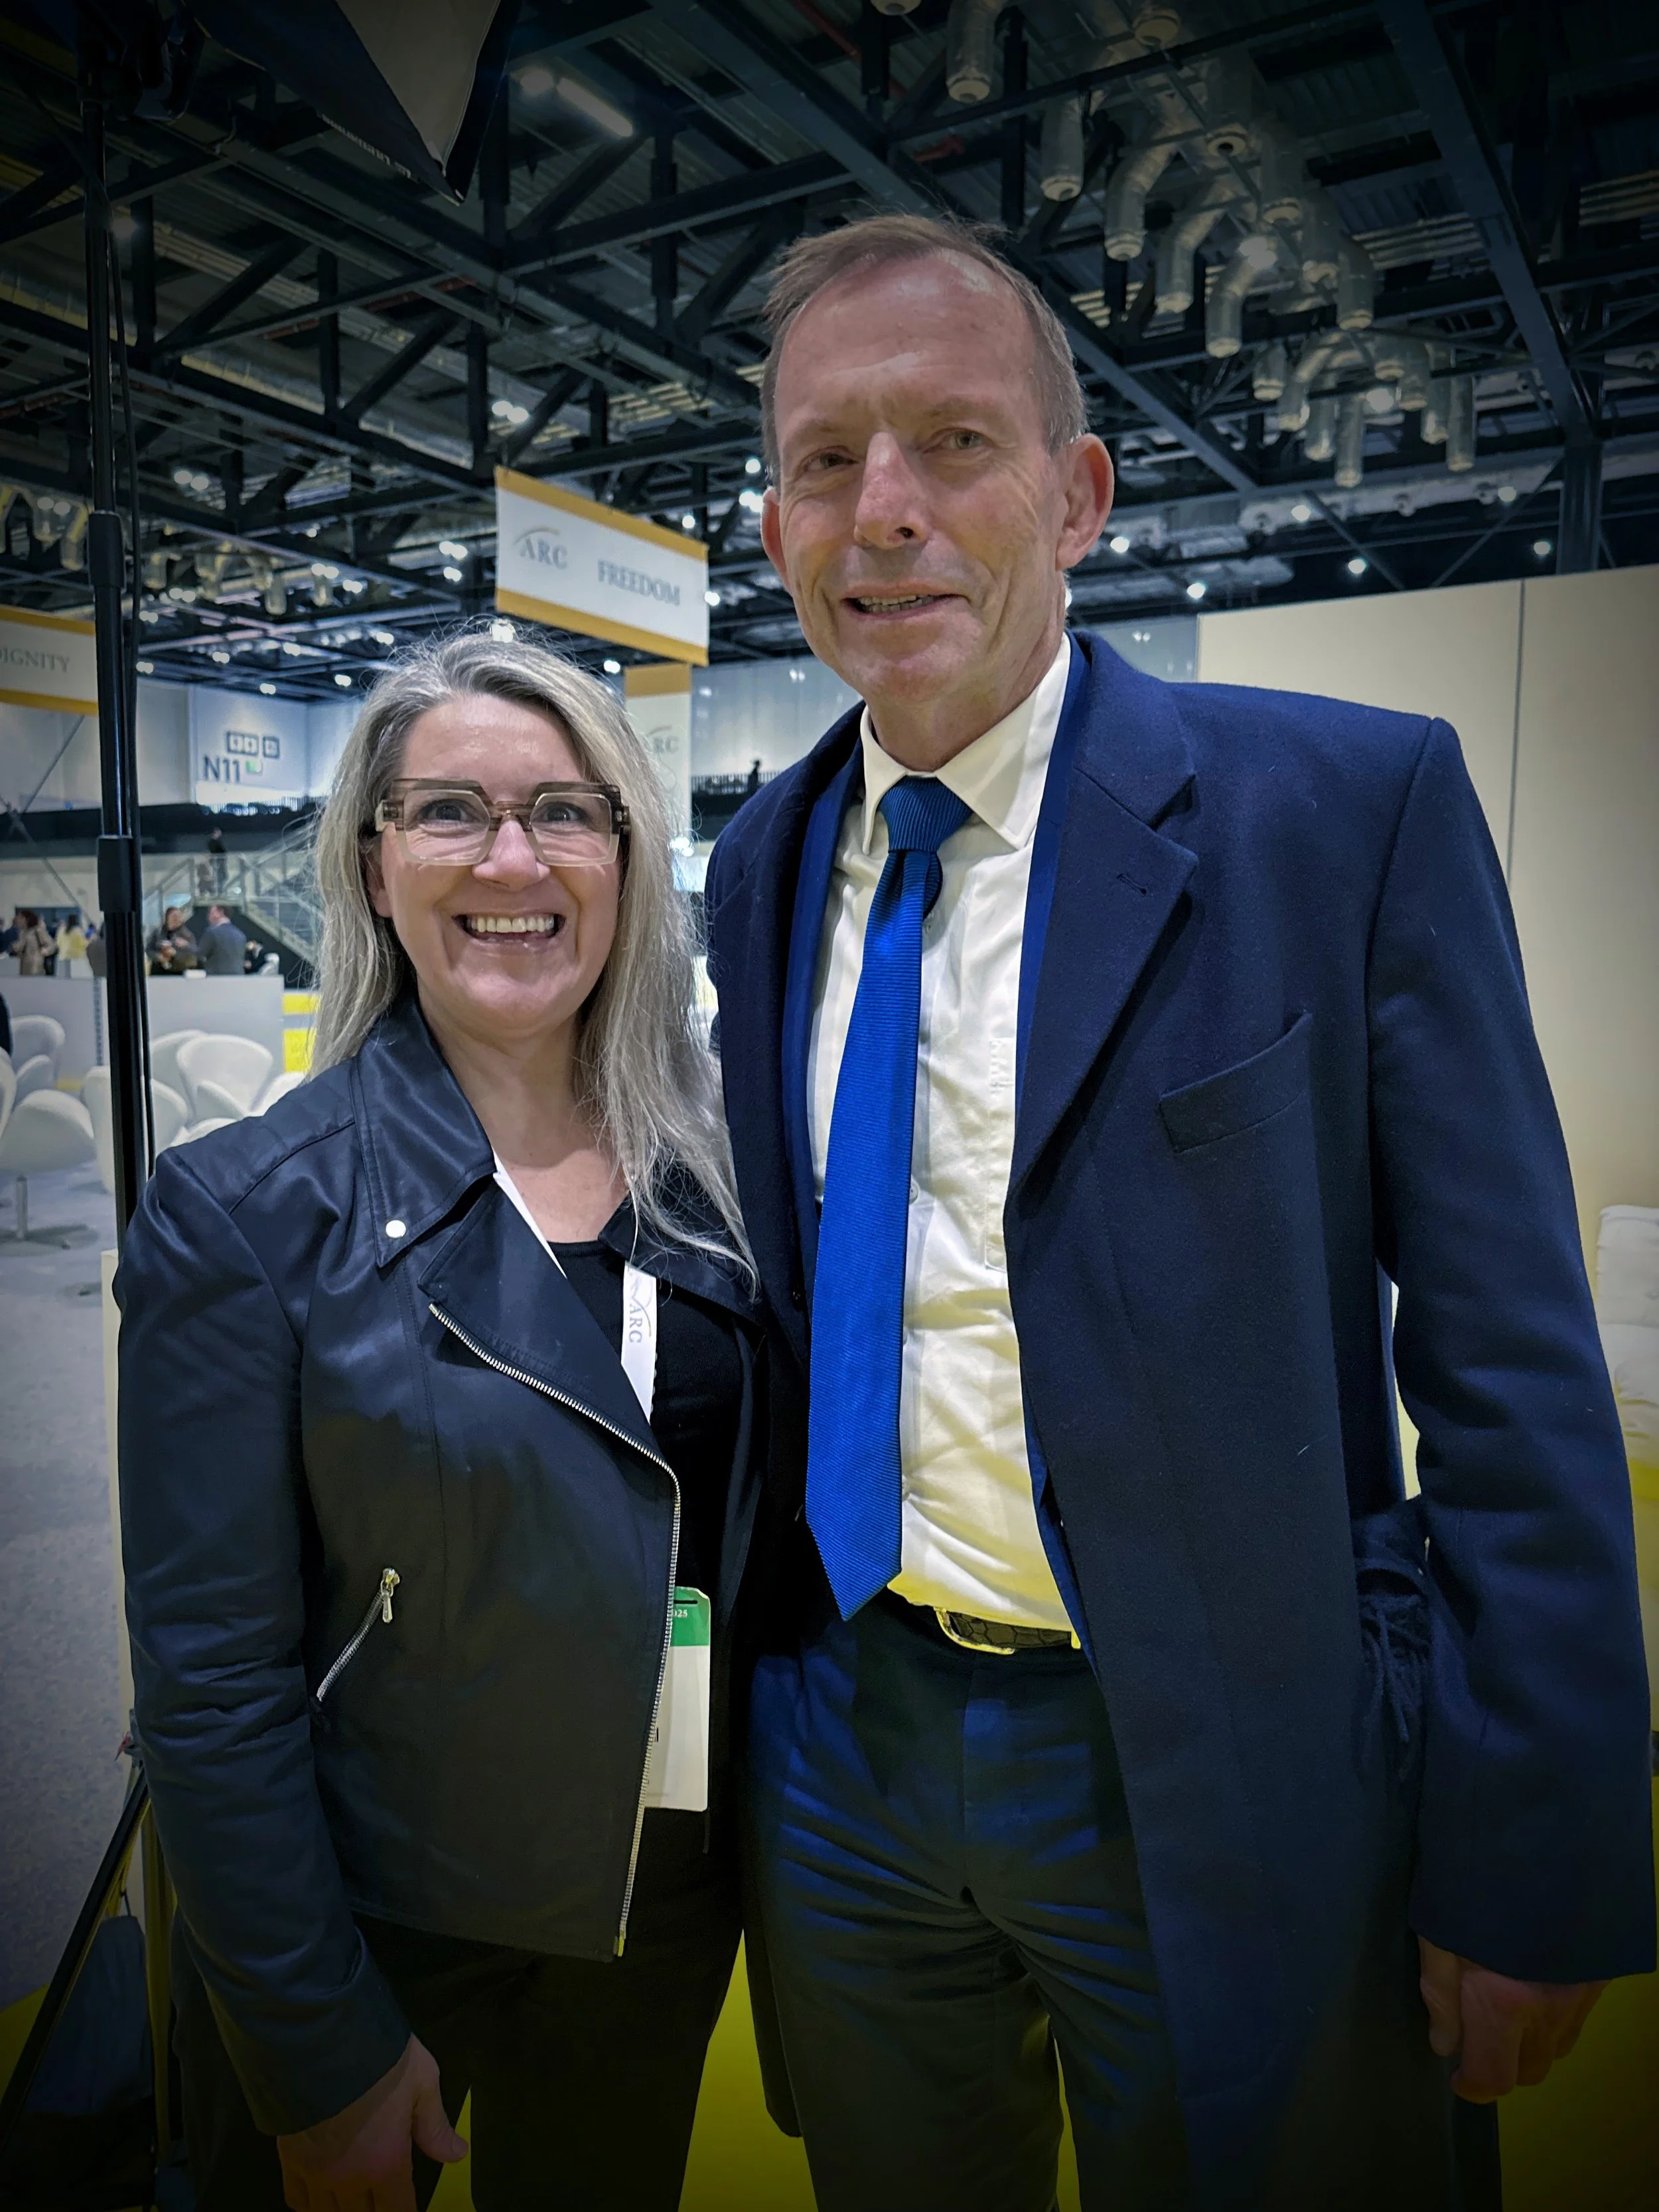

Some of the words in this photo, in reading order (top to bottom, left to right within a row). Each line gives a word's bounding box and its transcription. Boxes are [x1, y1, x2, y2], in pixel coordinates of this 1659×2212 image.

[520, 536, 567, 570] ARC
[598, 559, 680, 606] FREEDOM
[0, 646, 70, 672] IGNITY
[202, 755, 240, 783] N11
[628, 1303, 643, 1344] ARC
